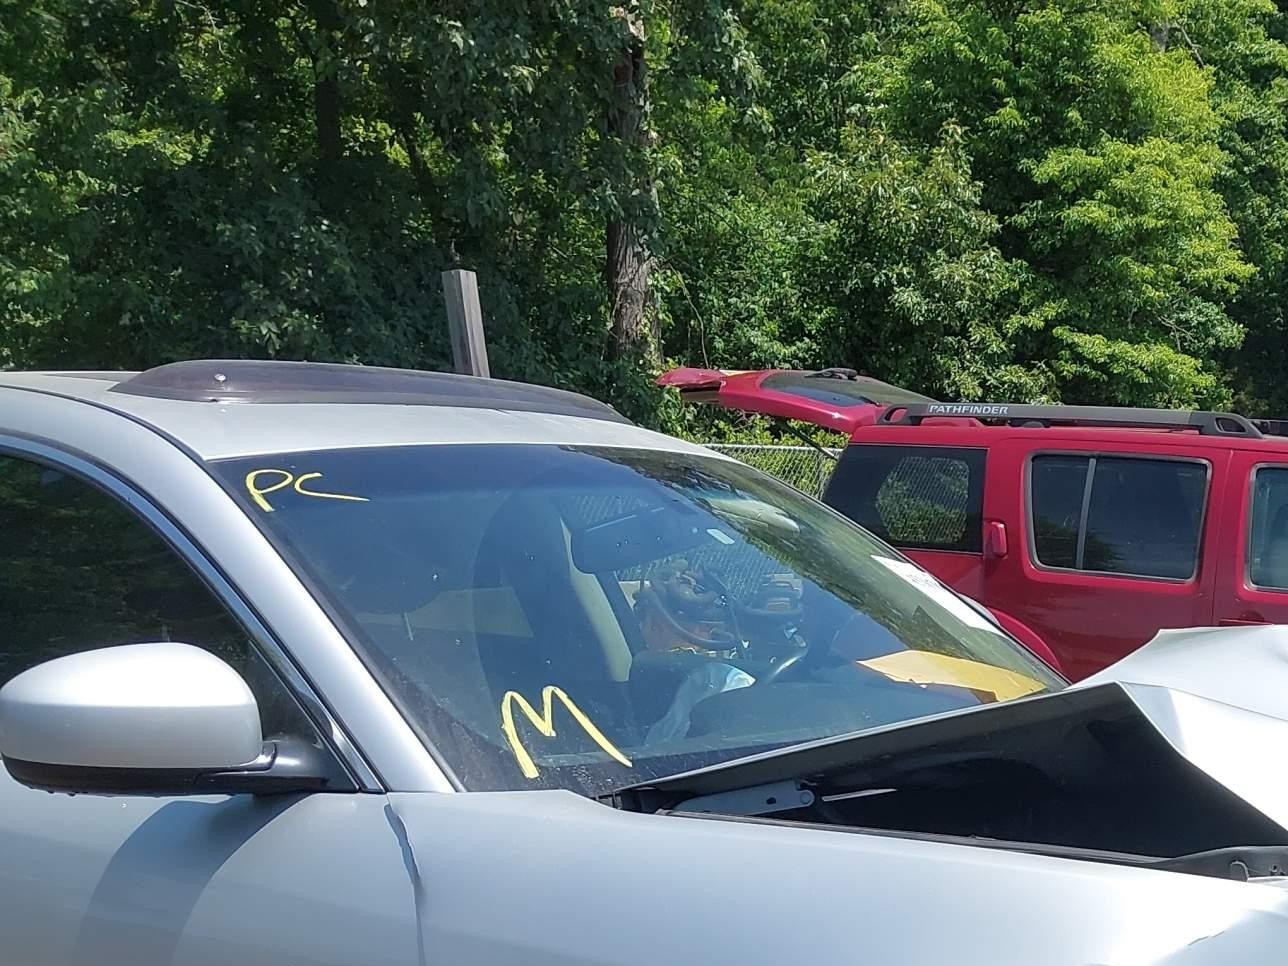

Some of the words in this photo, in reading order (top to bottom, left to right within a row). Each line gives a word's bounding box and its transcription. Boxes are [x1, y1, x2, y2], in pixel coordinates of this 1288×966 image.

[929, 404, 1009, 415] PATHFINDER
[245, 468, 371, 513] PC
[501, 685, 633, 778] M
